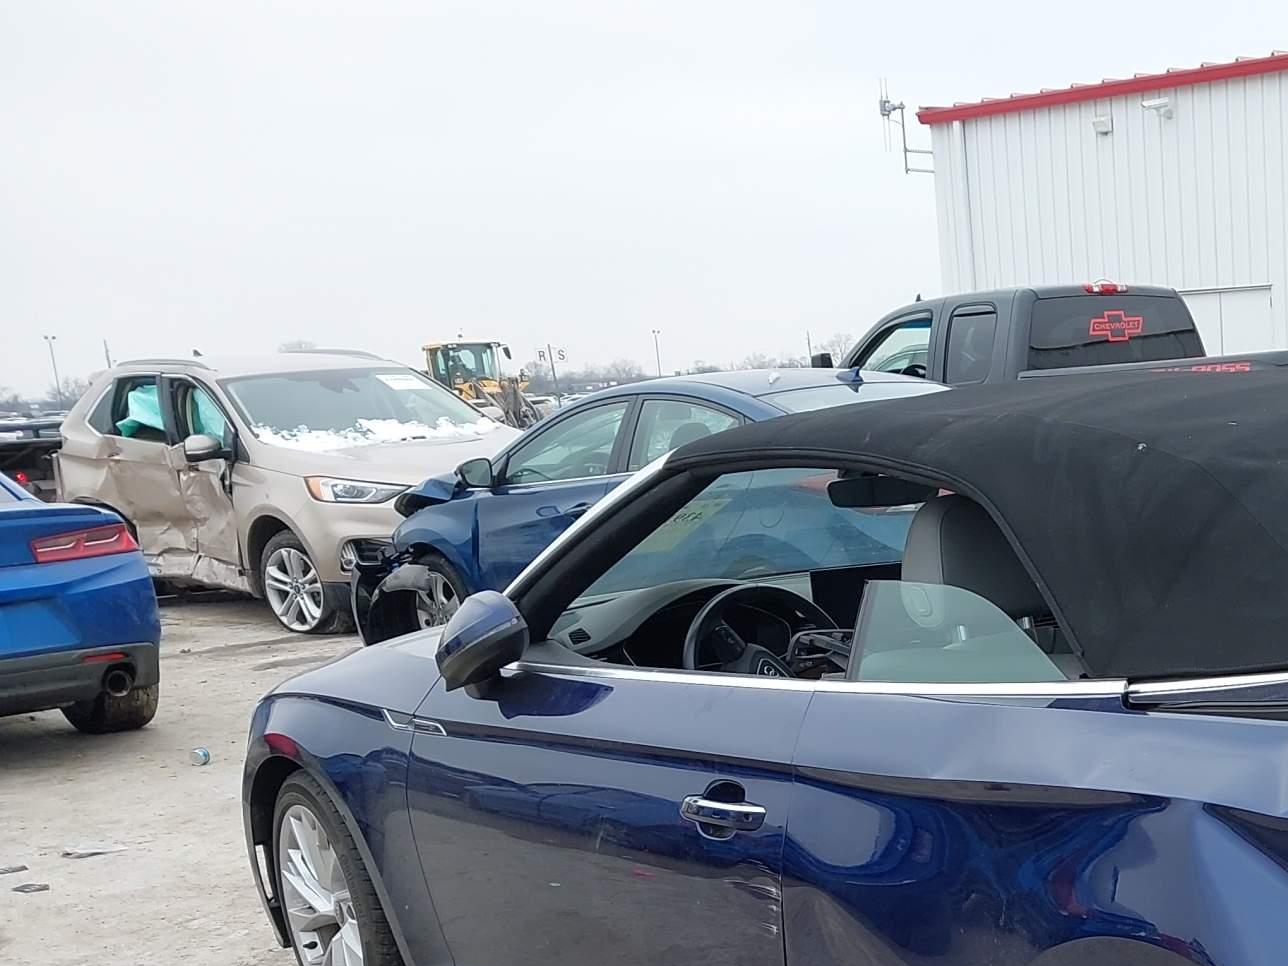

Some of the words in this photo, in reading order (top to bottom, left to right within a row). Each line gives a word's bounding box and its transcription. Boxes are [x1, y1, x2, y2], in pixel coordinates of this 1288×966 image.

[1093, 320, 1139, 331] CHEVROLET
[538, 350, 547, 361] R
[557, 349, 566, 361] S
